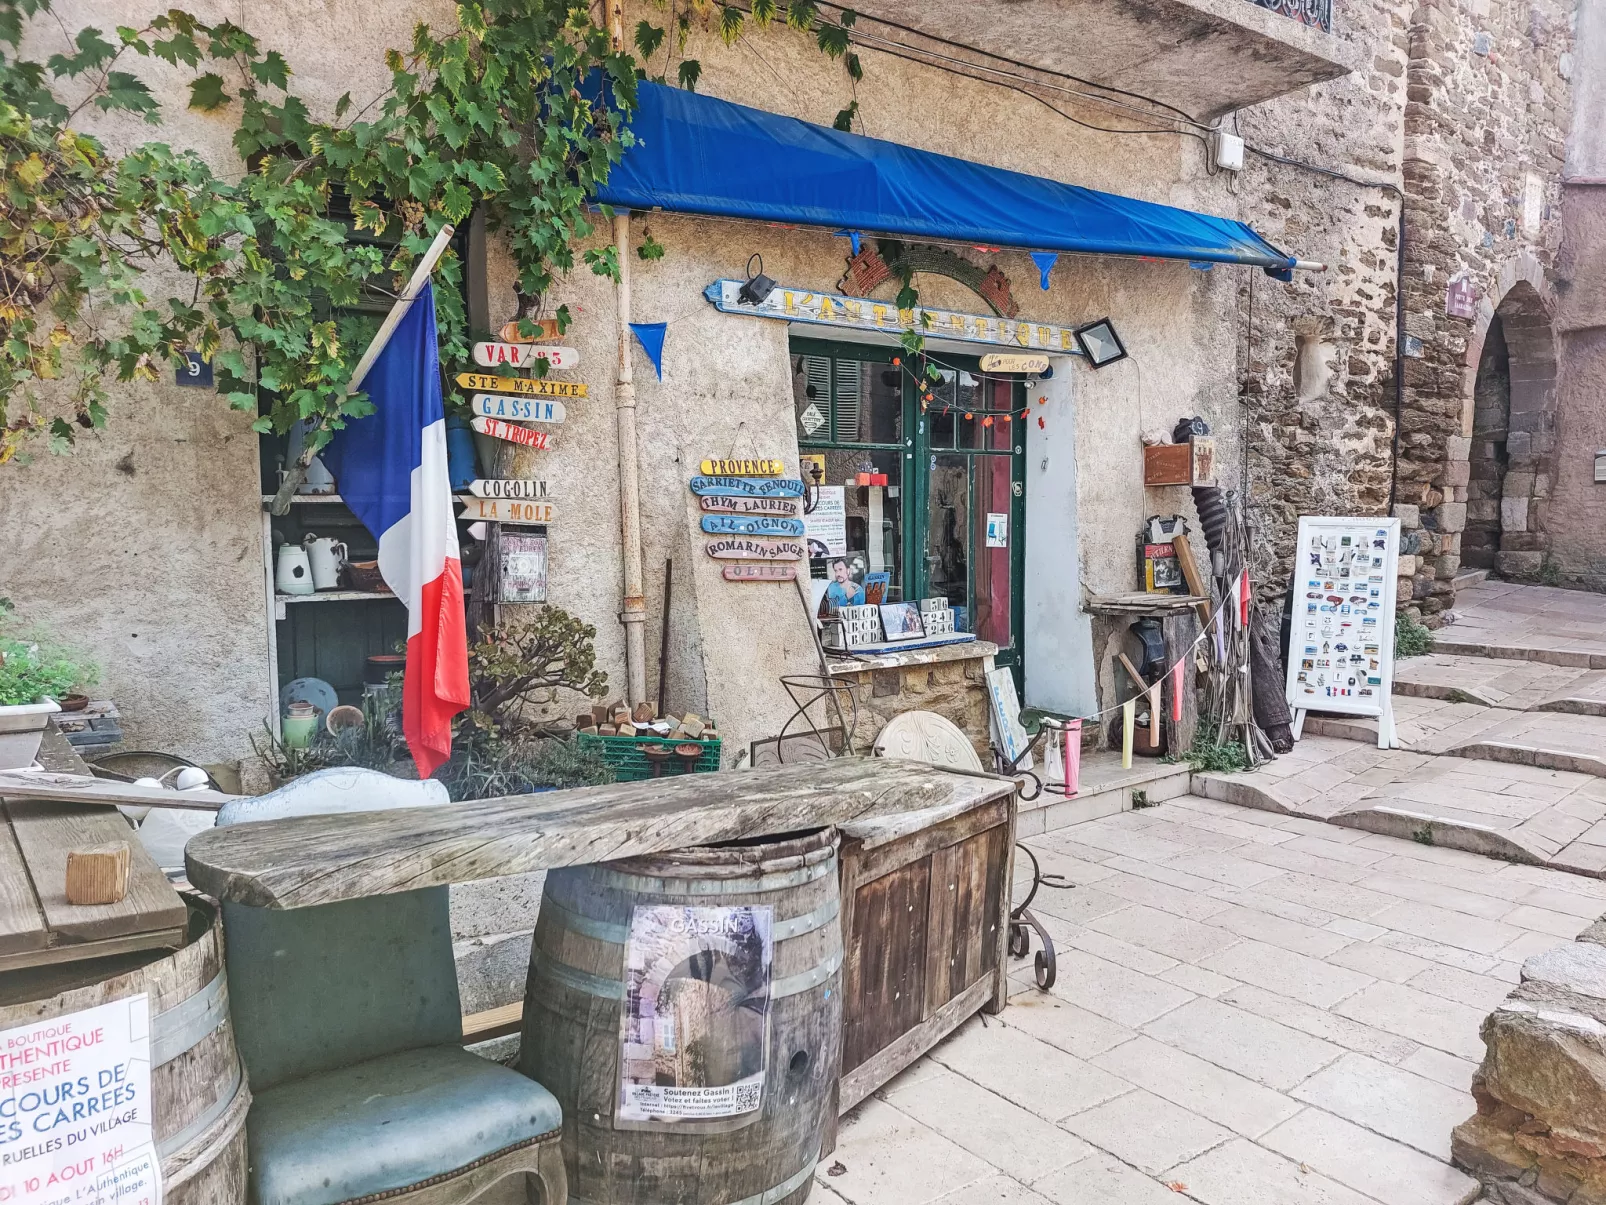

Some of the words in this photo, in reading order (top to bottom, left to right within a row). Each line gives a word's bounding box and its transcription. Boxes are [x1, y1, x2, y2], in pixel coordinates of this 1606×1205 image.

[485, 344, 520, 364] VAR
[188, 361, 201, 377] 9
[468, 375, 499, 389] STE
[514, 379, 580, 396] MAXIME
[482, 397, 554, 420] GASSIN
[711, 459, 775, 475] PROVENCE
[482, 480, 548, 498] COGOLIN
[692, 475, 756, 495] SARRIETTE
[479, 500, 498, 519] LA
[510, 502, 553, 522] MOLE
[702, 496, 738, 511] THYM
[743, 499, 798, 515] LAURIER
[710, 517, 737, 532] AIL
[746, 518, 799, 534] OIGNON
[708, 541, 768, 558] ROMARIN
[769, 543, 805, 559] SAUGE
[733, 565, 789, 577] OLIVE
[670, 917, 739, 934] GASSIN
[7, 1022, 72, 1049] BOUTIQUE
[0, 1059, 72, 1090] RESENTE
[0, 1076, 90, 1118] COURS
[98, 1063, 125, 1090] DE
[663, 1088, 702, 1097] Soutenez
[703, 1087, 730, 1097] Gassin
[33, 1082, 136, 1133] CARREES
[3, 1139, 63, 1167] RUELLES
[67, 1128, 87, 1147] DU
[90, 1107, 138, 1137] VILLAGE
[23, 1176, 40, 1194] 10
[46, 1156, 95, 1188] AOUT
[102, 1143, 124, 1166] 16H
[76, 1161, 149, 1200] L'Authentique
[110, 1179, 147, 1201] village.
